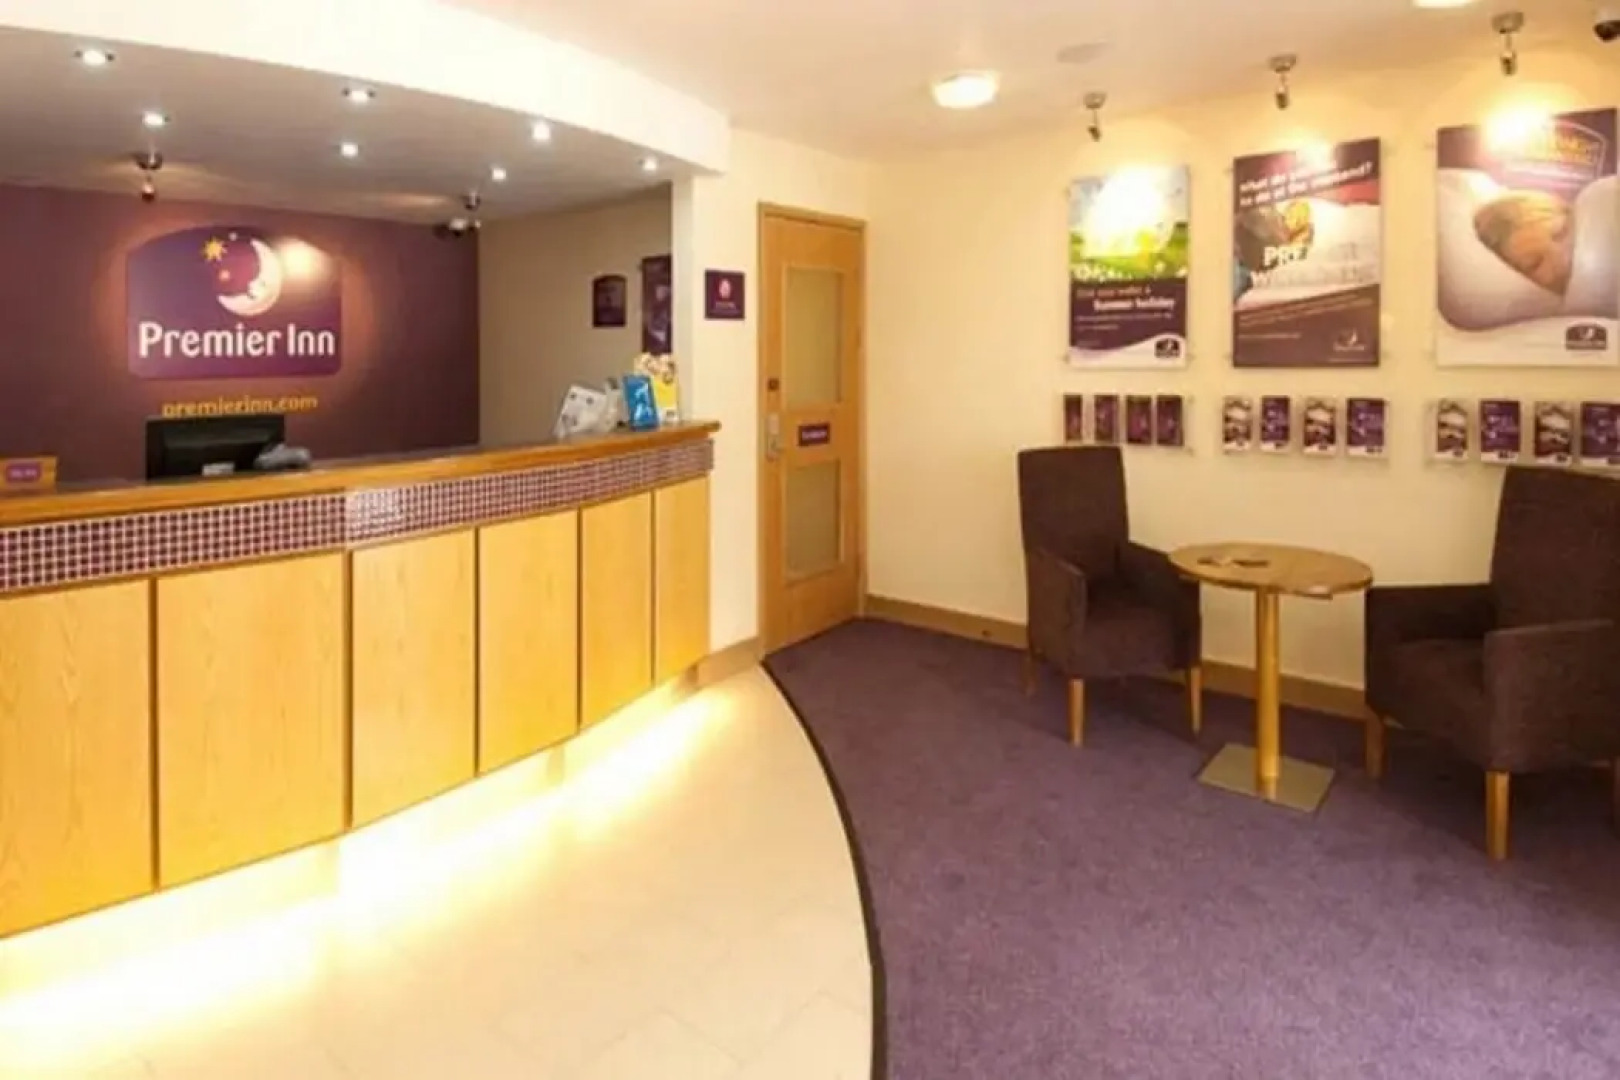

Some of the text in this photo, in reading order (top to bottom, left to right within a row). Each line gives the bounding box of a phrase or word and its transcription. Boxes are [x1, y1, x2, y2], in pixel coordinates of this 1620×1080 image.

[138, 321, 336, 359] Premier Inn
[161, 395, 319, 418] premierinn.com
